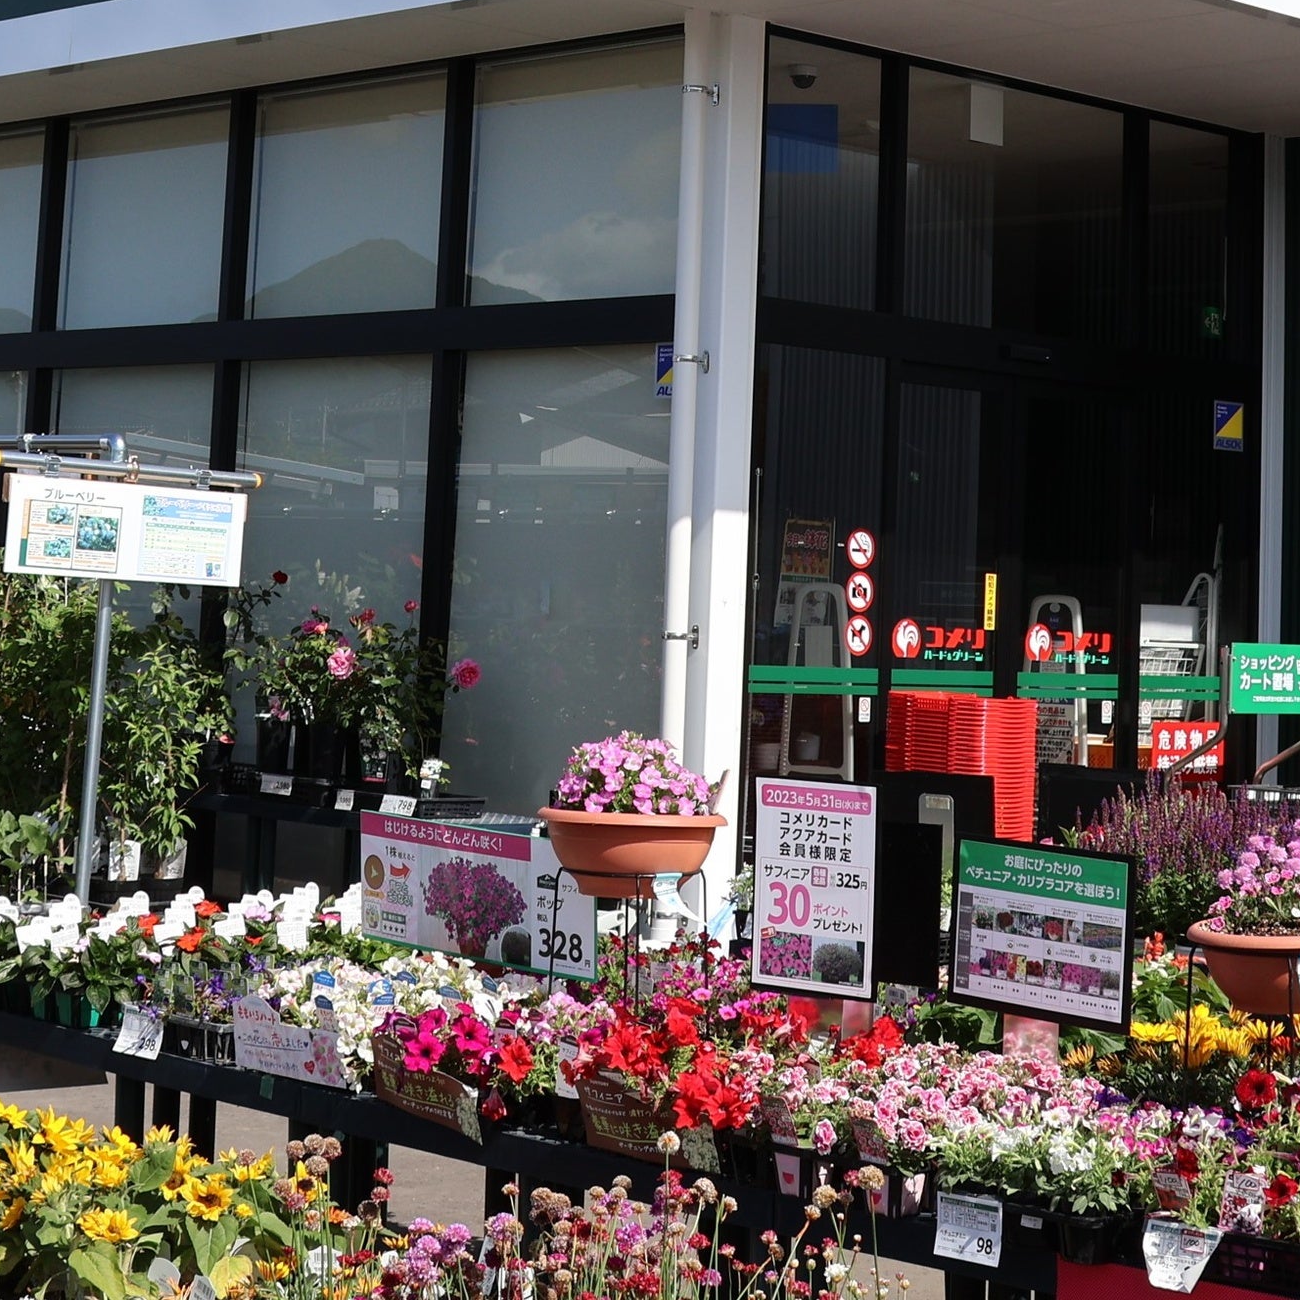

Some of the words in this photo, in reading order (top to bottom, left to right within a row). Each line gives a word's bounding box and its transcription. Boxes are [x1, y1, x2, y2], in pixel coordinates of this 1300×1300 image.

[44, 488, 106, 502] ブルーベリー
[925, 626, 986, 649] コメリ
[1055, 631, 1113, 653] コメリ
[923, 649, 984, 662] ハード&グリーン
[1240, 654, 1295, 671] ショッピング
[1239, 672, 1294, 692] カート置場
[1157, 729, 1219, 750] 危険物品
[766, 789, 869, 811] 2023年5月31日(水)まで
[780, 812, 853, 830] コメリカード
[384, 819, 502, 852] はじけるようにどんどん咲く!
[780, 827, 852, 845] アクアカード
[779, 842, 852, 862] 会員様限定
[764, 863, 810, 880] サフィニア
[1004, 854, 1082, 878] お庭にぴったりの
[965, 865, 1121, 900] ペチュニア・カリブラコアを選ぼう!
[536, 896, 565, 911] ポップ
[767, 881, 811, 927] 30
[813, 903, 849, 917] ポイント
[812, 918, 863, 935] プレゼント!
[140, 1038, 156, 1052] 298
[583, 1086, 624, 1104] サフィニア
[976, 1236, 993, 1255] 98
